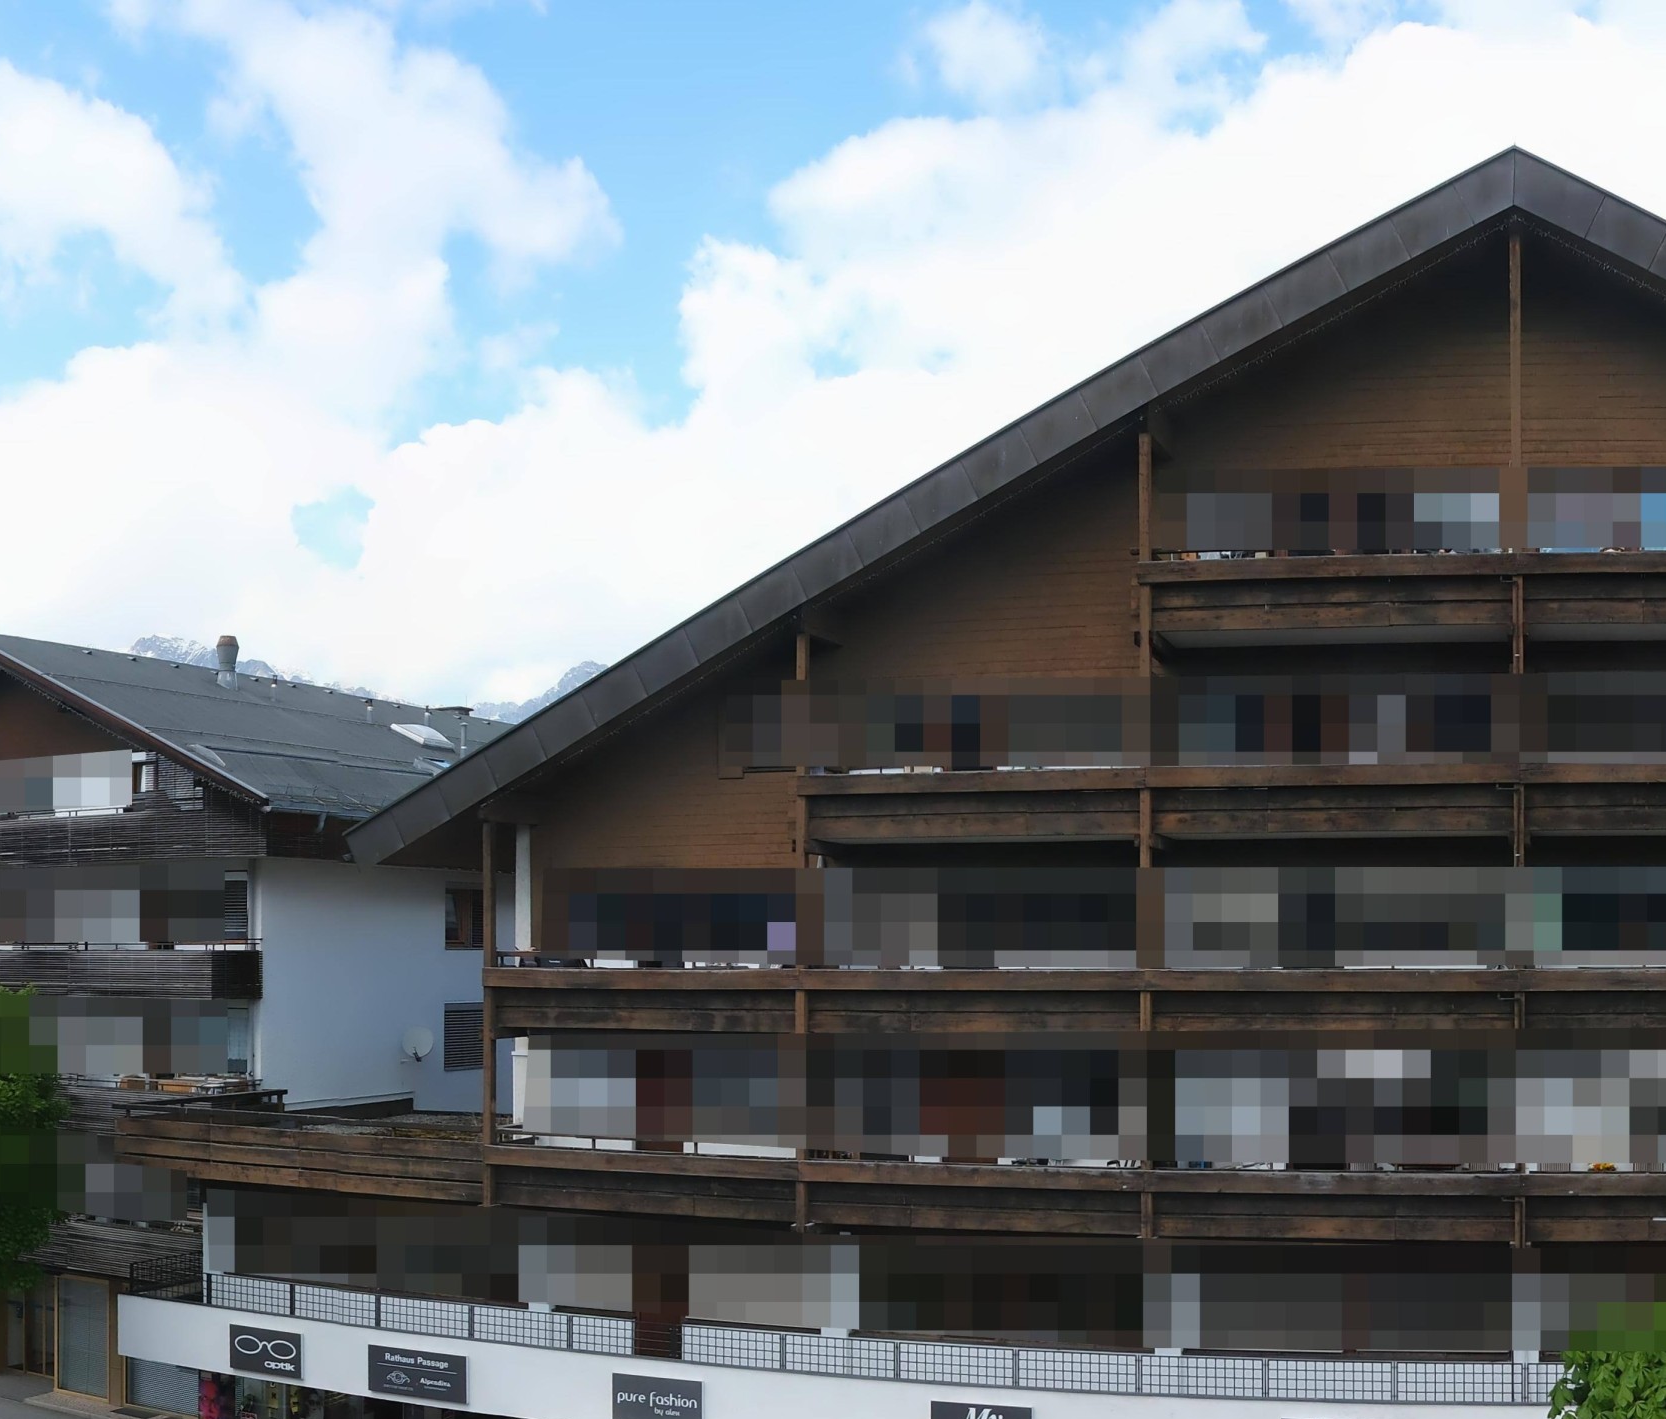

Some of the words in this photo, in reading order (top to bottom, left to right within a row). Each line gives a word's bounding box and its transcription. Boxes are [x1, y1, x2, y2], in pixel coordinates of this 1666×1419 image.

[264, 1360, 296, 1372] optik
[384, 1352, 415, 1364] Rathaus
[417, 1356, 449, 1369] Passage
[616, 1390, 646, 1404] pure
[649, 1391, 697, 1409] fashion
[654, 1406, 663, 1417] by
